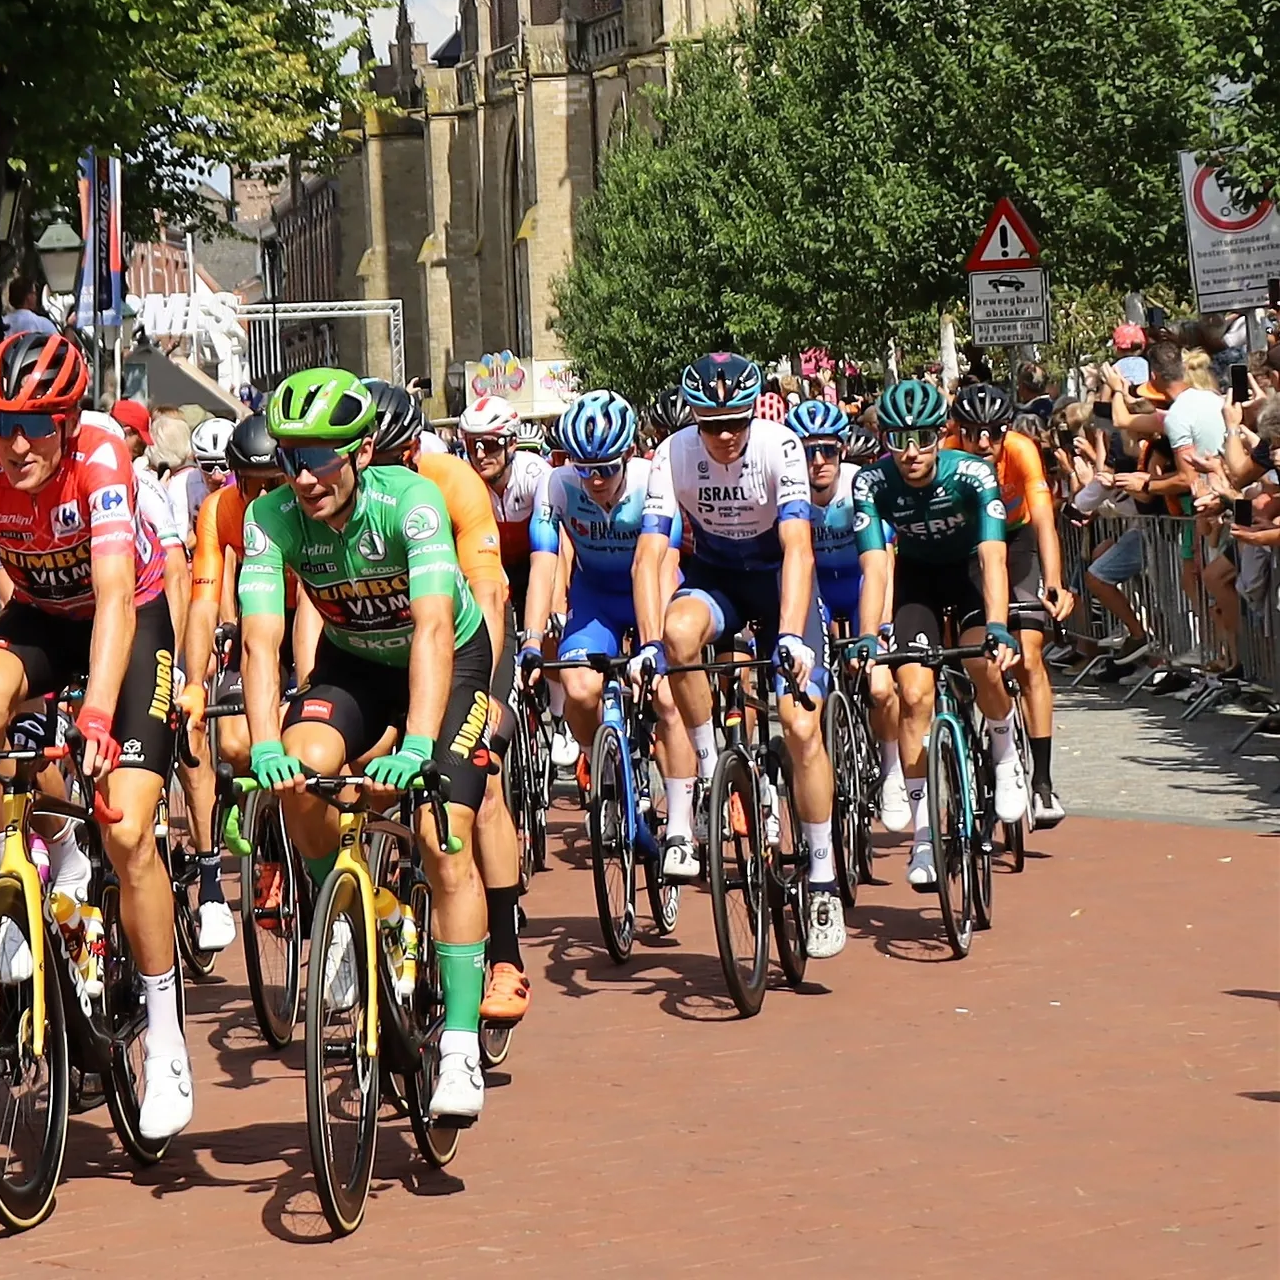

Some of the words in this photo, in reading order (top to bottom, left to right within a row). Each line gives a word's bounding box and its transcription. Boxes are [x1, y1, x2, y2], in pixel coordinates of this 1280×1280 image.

[976, 295, 1039, 307] beweegbaar
[986, 307, 1032, 318] obstakel
[992, 322, 1017, 334] groen
[698, 486, 748, 501] ISRAEL
[896, 514, 966, 534] KERN
[32, 563, 91, 586] VISM
[347, 593, 410, 616] VISM
[149, 649, 173, 723] JUMBO
[450, 690, 490, 760] JUMBO
